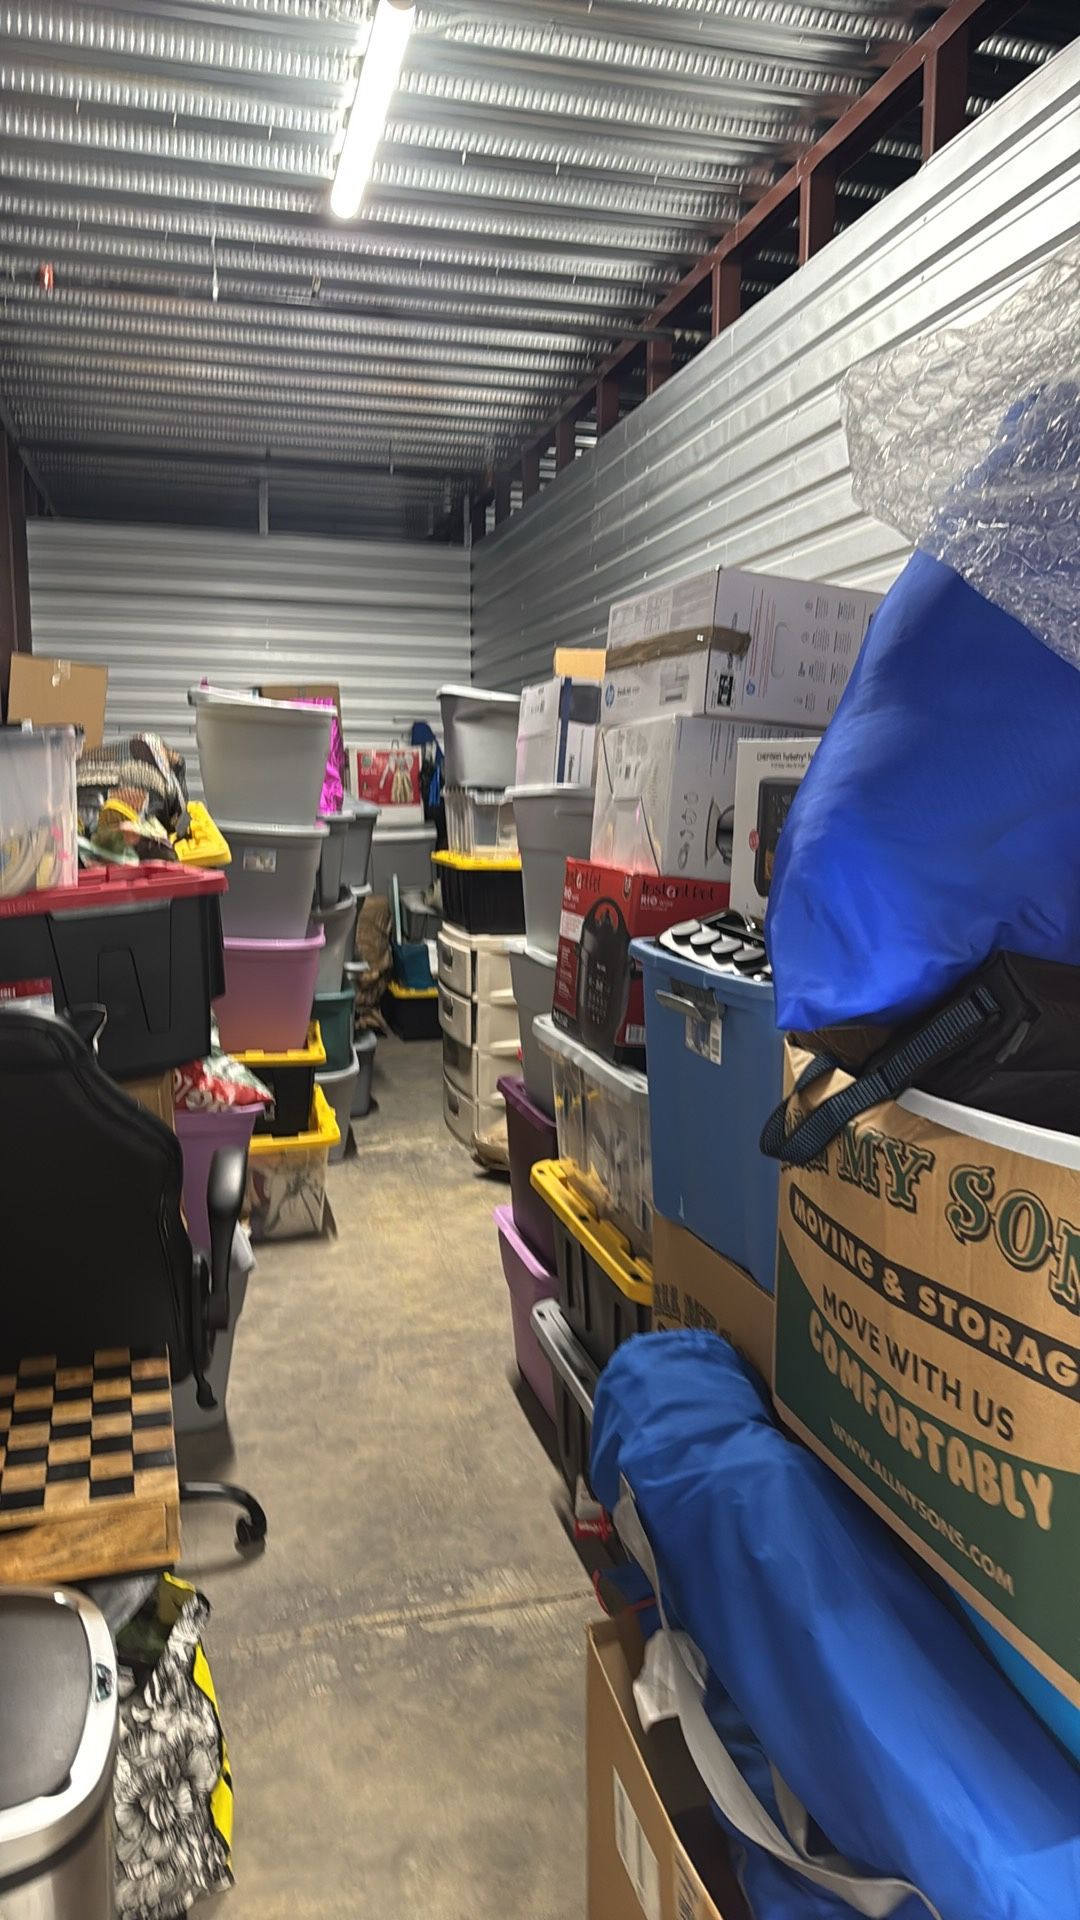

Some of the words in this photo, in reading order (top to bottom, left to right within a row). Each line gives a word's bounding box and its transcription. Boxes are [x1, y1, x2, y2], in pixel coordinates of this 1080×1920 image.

[837, 1121, 935, 1213] MY
[793, 1193, 874, 1279] MOVING
[882, 1266, 907, 1303] &
[917, 1285, 1080, 1388] STORAG
[822, 1284, 880, 1354] MOVE
[885, 1333, 962, 1410] WITH
[973, 1390, 1014, 1441] US
[808, 1308, 1054, 1531] COMFORTABLY
[828, 1415, 1016, 1597] WWW.ALLMYSONS.COM
